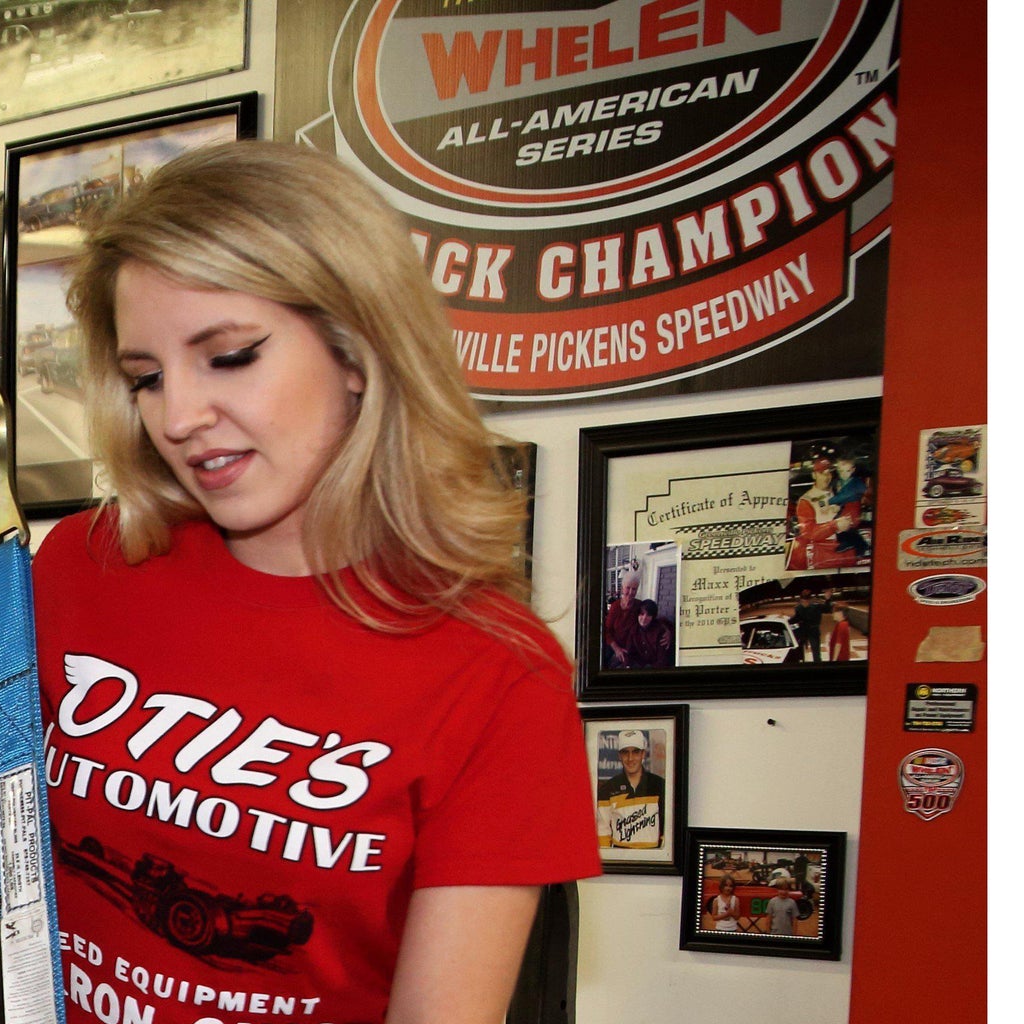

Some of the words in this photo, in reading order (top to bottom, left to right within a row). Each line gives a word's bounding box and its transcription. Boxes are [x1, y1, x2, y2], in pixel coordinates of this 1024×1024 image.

[421, 0, 781, 101] WHELEN
[857, 72, 880, 86] TM
[436, 67, 760, 151] ALL-AMERICAN
[515, 120, 664, 167] SERIES
[536, 96, 898, 300] CHAMPION
[452, 329, 524, 373] VILLE
[530, 319, 647, 373] PICKENS
[656, 252, 815, 355] SPEEDWAY
[647, 498, 716, 527] Certificate
[719, 492, 734, 508] of
[688, 533, 785, 552] SPEEDWAY
[691, 577, 729, 591] Maxx
[695, 604, 729, 617] Porter
[58, 653, 392, 810] OTIE'S
[906, 794, 950, 810] 500
[28, 832, 38, 883] PRODUCTS
[59, 931, 103, 966] EED
[115, 956, 321, 1016] EQUIPMENT
